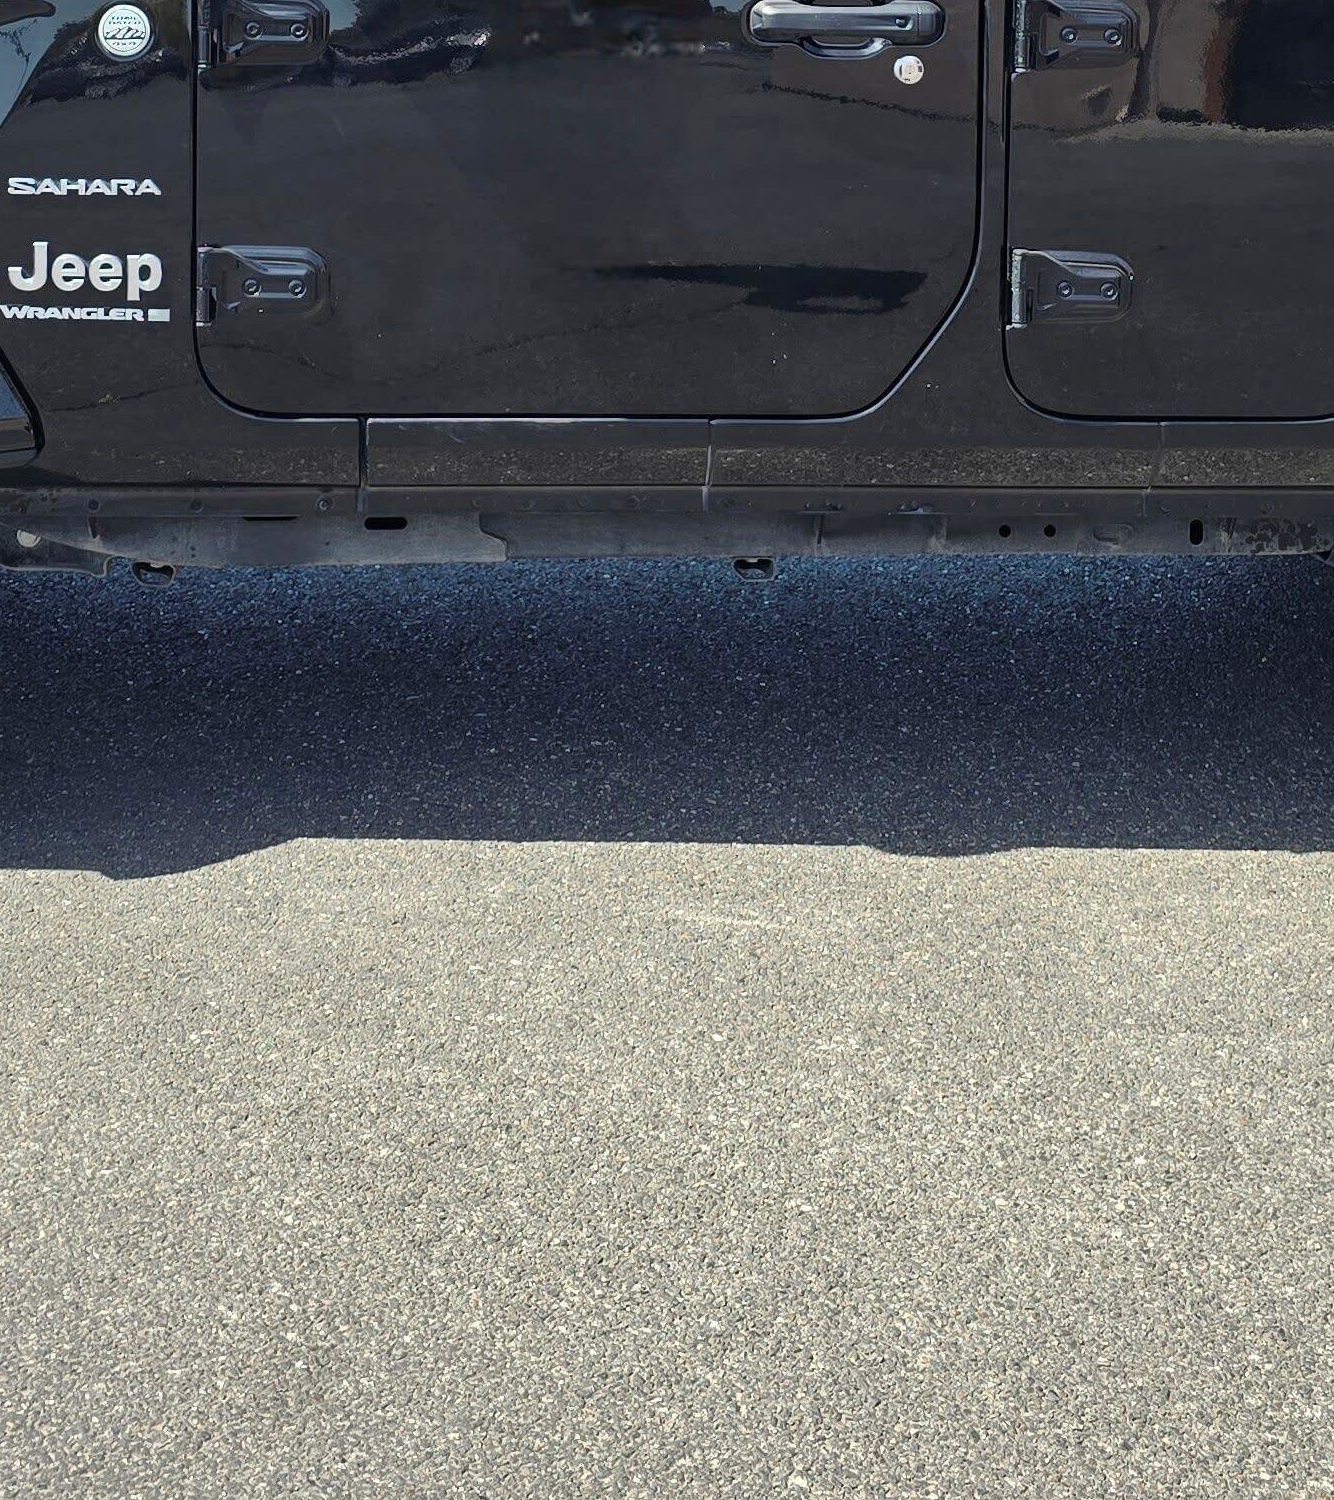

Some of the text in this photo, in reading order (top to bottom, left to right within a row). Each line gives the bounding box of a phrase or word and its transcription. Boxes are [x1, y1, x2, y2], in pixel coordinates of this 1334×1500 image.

[7, 177, 162, 196] SAHARA
[7, 241, 163, 302] Jeep
[0, 304, 145, 322] WRANGLER
